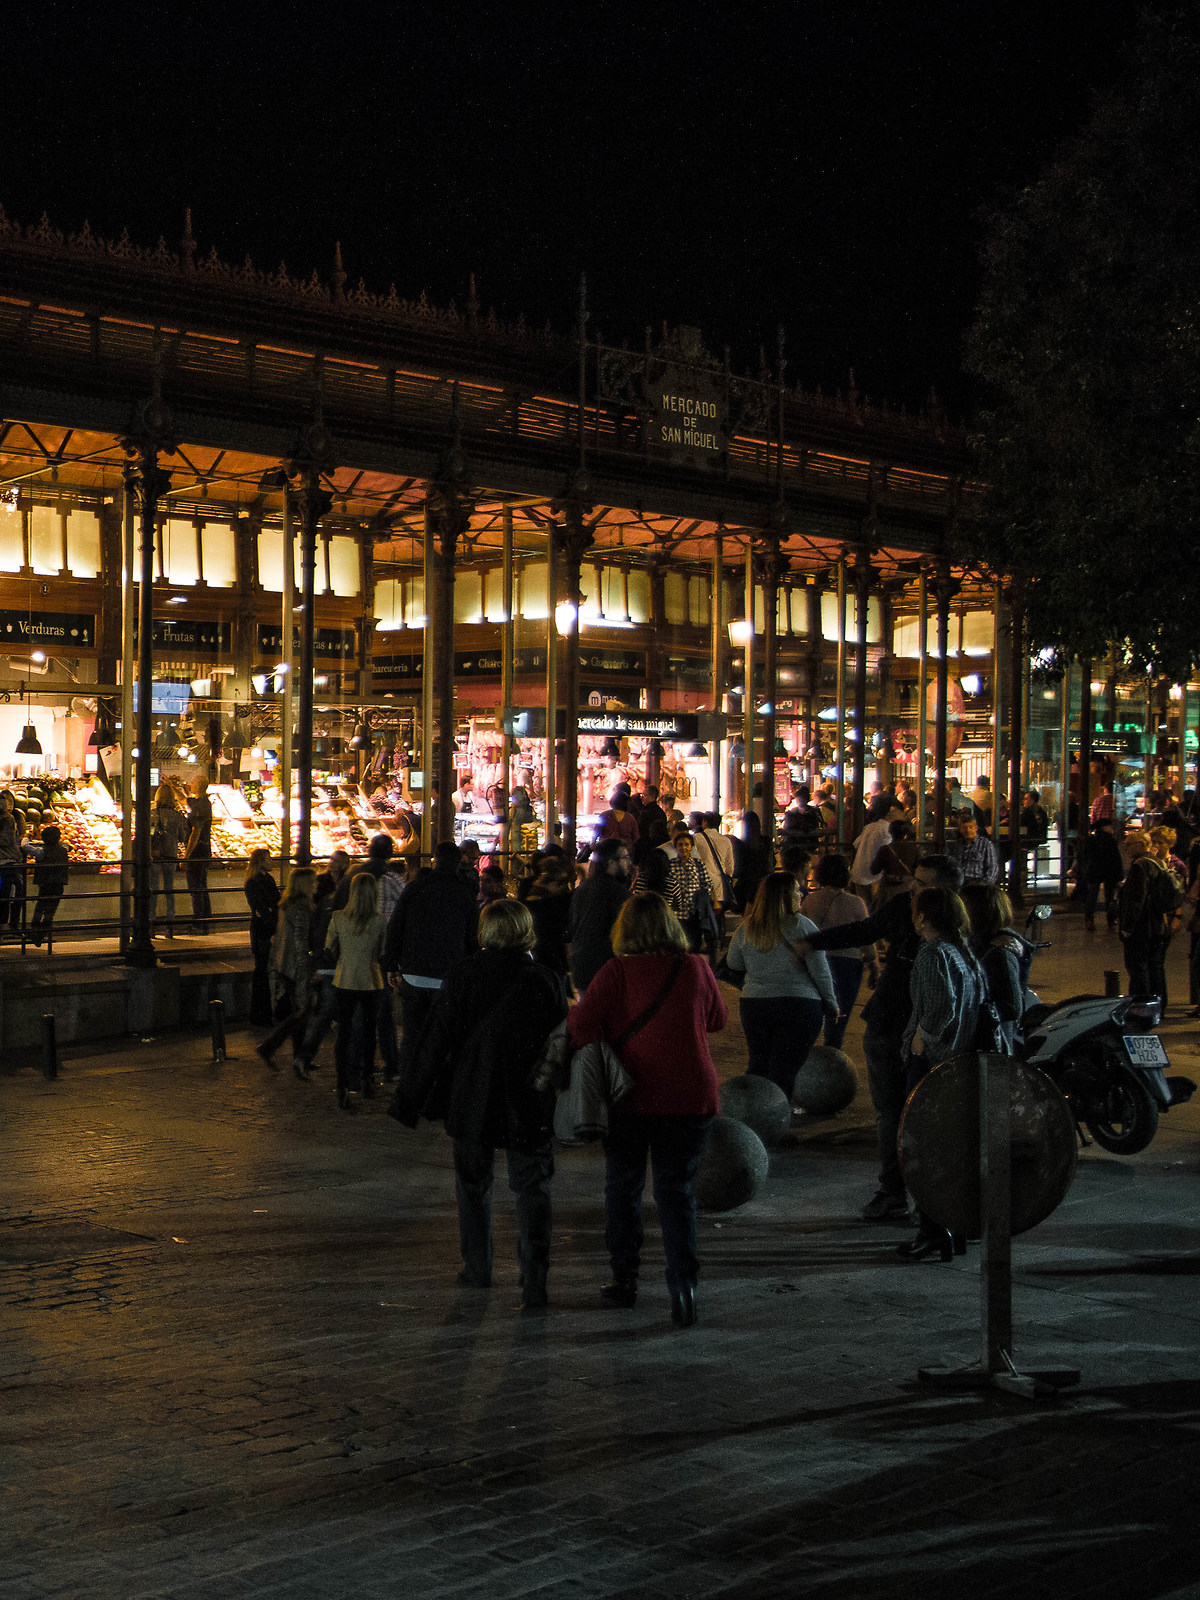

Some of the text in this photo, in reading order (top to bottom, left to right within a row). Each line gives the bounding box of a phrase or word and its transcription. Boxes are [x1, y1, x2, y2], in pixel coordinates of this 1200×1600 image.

[662, 395, 717, 418] MERCADO
[683, 416, 697, 428] DE
[661, 426, 719, 450] SAN MIGUEL
[18, 620, 65, 636] Verduras
[163, 628, 195, 642] Frutas
[628, 719, 644, 731] san
[646, 717, 677, 736] miguel
[1133, 1037, 1160, 1049] 0796
